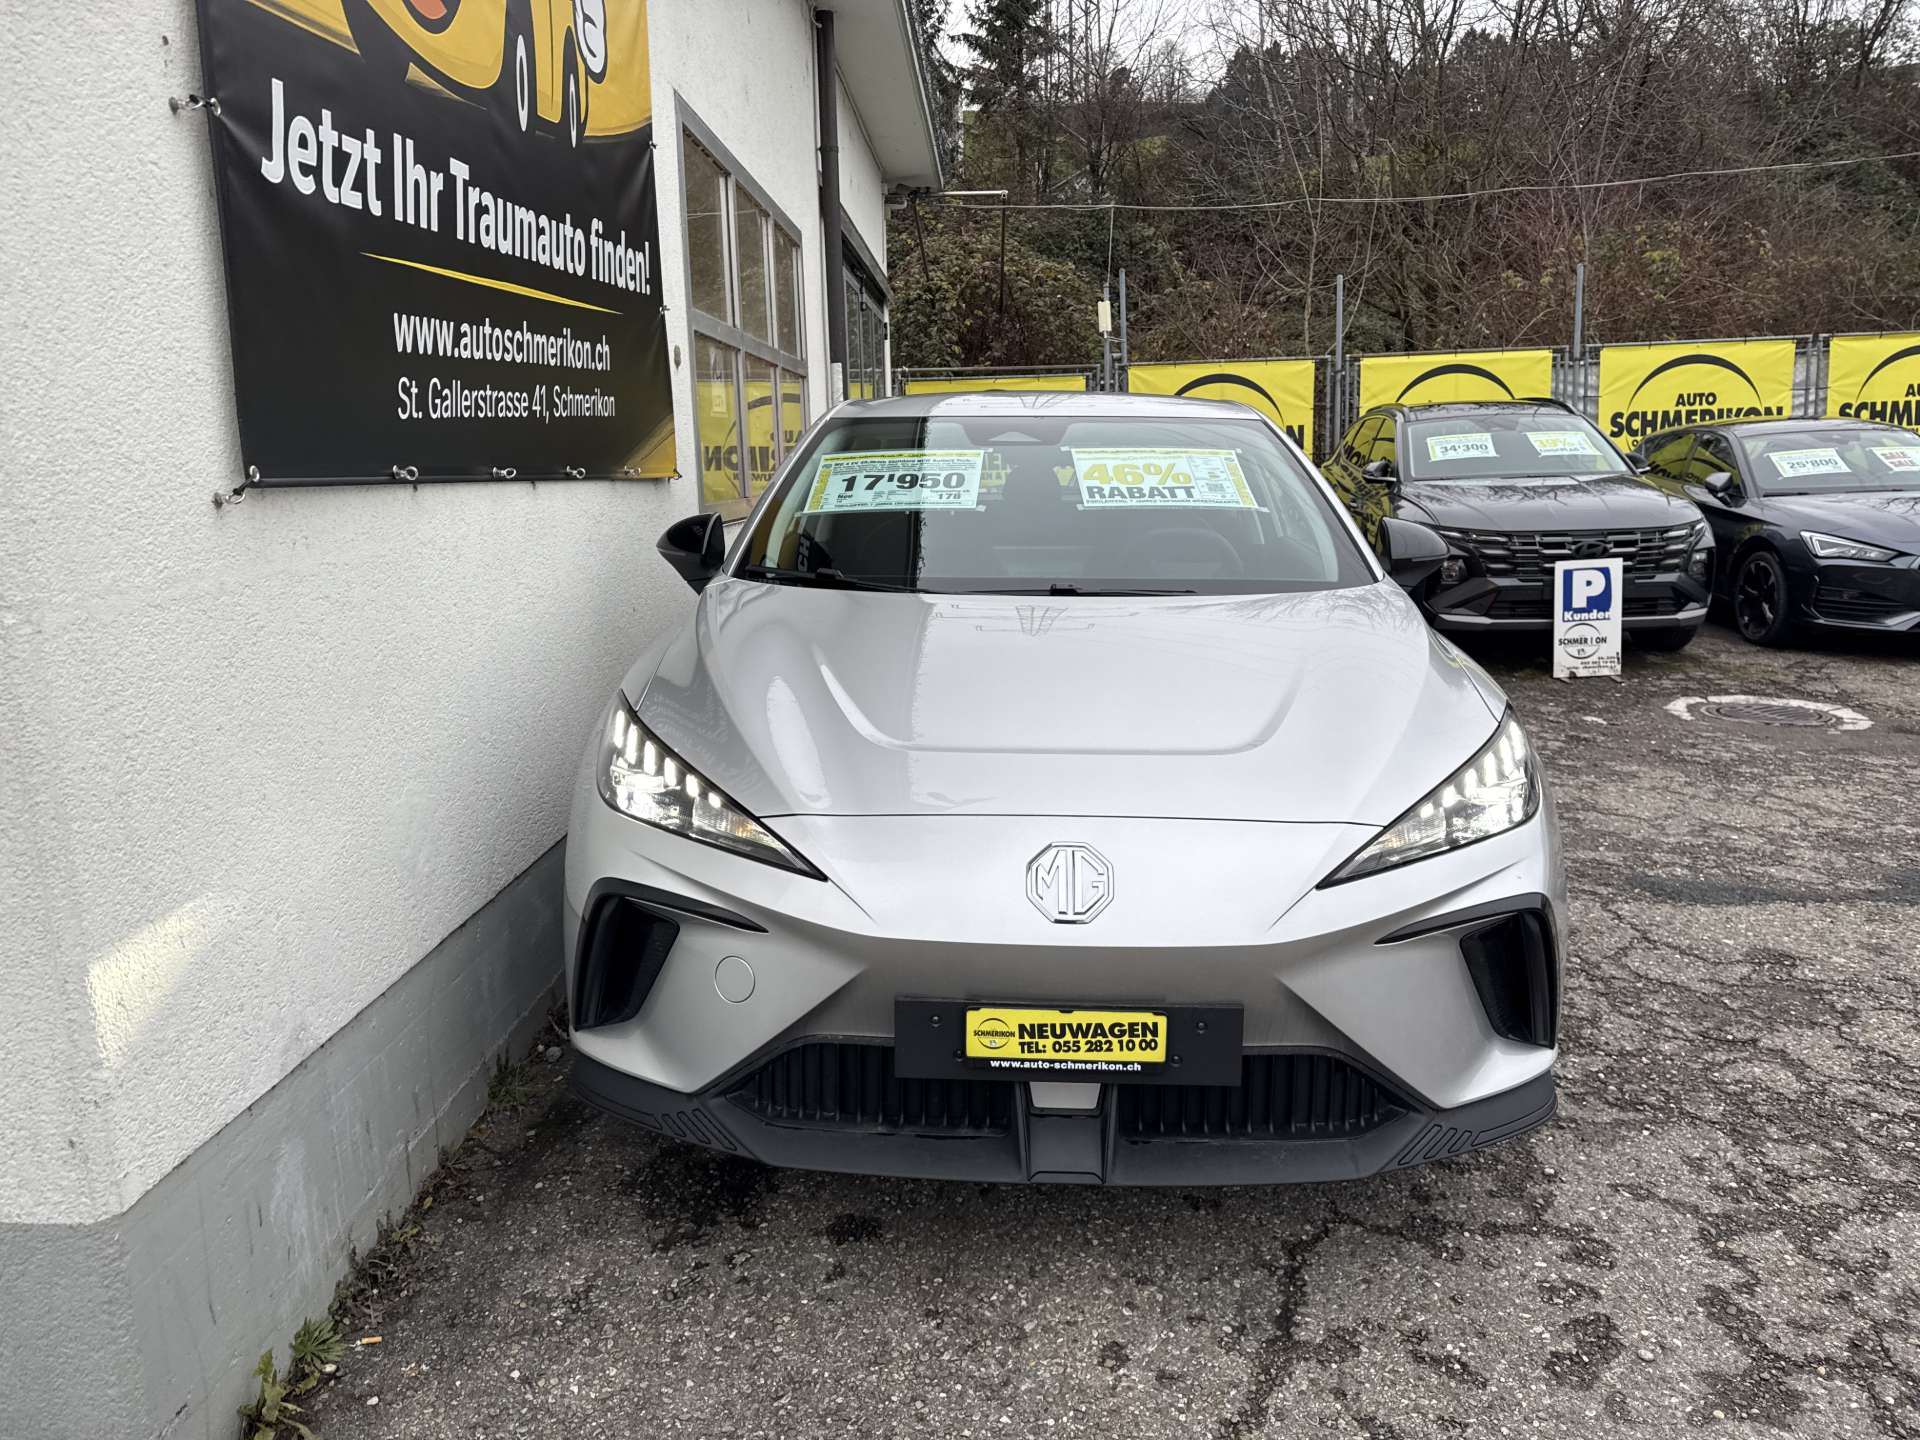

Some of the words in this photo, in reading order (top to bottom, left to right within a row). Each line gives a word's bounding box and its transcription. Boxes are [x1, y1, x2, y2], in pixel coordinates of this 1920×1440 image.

[260, 77, 382, 216] Jetzt
[392, 132, 443, 232] Ihr
[450, 157, 586, 276] Traumauto
[589, 217, 651, 295] finden!
[393, 312, 611, 371] www.autoschmerikon.ch
[397, 376, 423, 421] St.
[428, 377, 529, 419] Gallerstrasse
[532, 384, 550, 424] 41,
[553, 385, 616, 418] Schmerikon
[1675, 392, 1717, 407] AUTO
[1440, 443, 1489, 453] 34'300
[1786, 458, 1839, 469] 25'800
[842, 472, 966, 492] 17'950
[1083, 463, 1192, 485] 46%
[1085, 486, 1196, 499] RABATT
[1572, 569, 1606, 608] P
[1032, 847, 1107, 916] MG
[974, 1030, 1016, 1038] SCHMERIKON
[1018, 1021, 1159, 1040] NEUWAGEN
[1018, 1041, 1047, 1054] TEL:
[1052, 1040, 1081, 1053] 055
[1084, 1040, 1114, 1053] 282
[1118, 1040, 1136, 1053] 10
[1138, 1039, 1159, 1052] 00
[990, 1059, 1142, 1072] www.auto-schmerikon.ch
